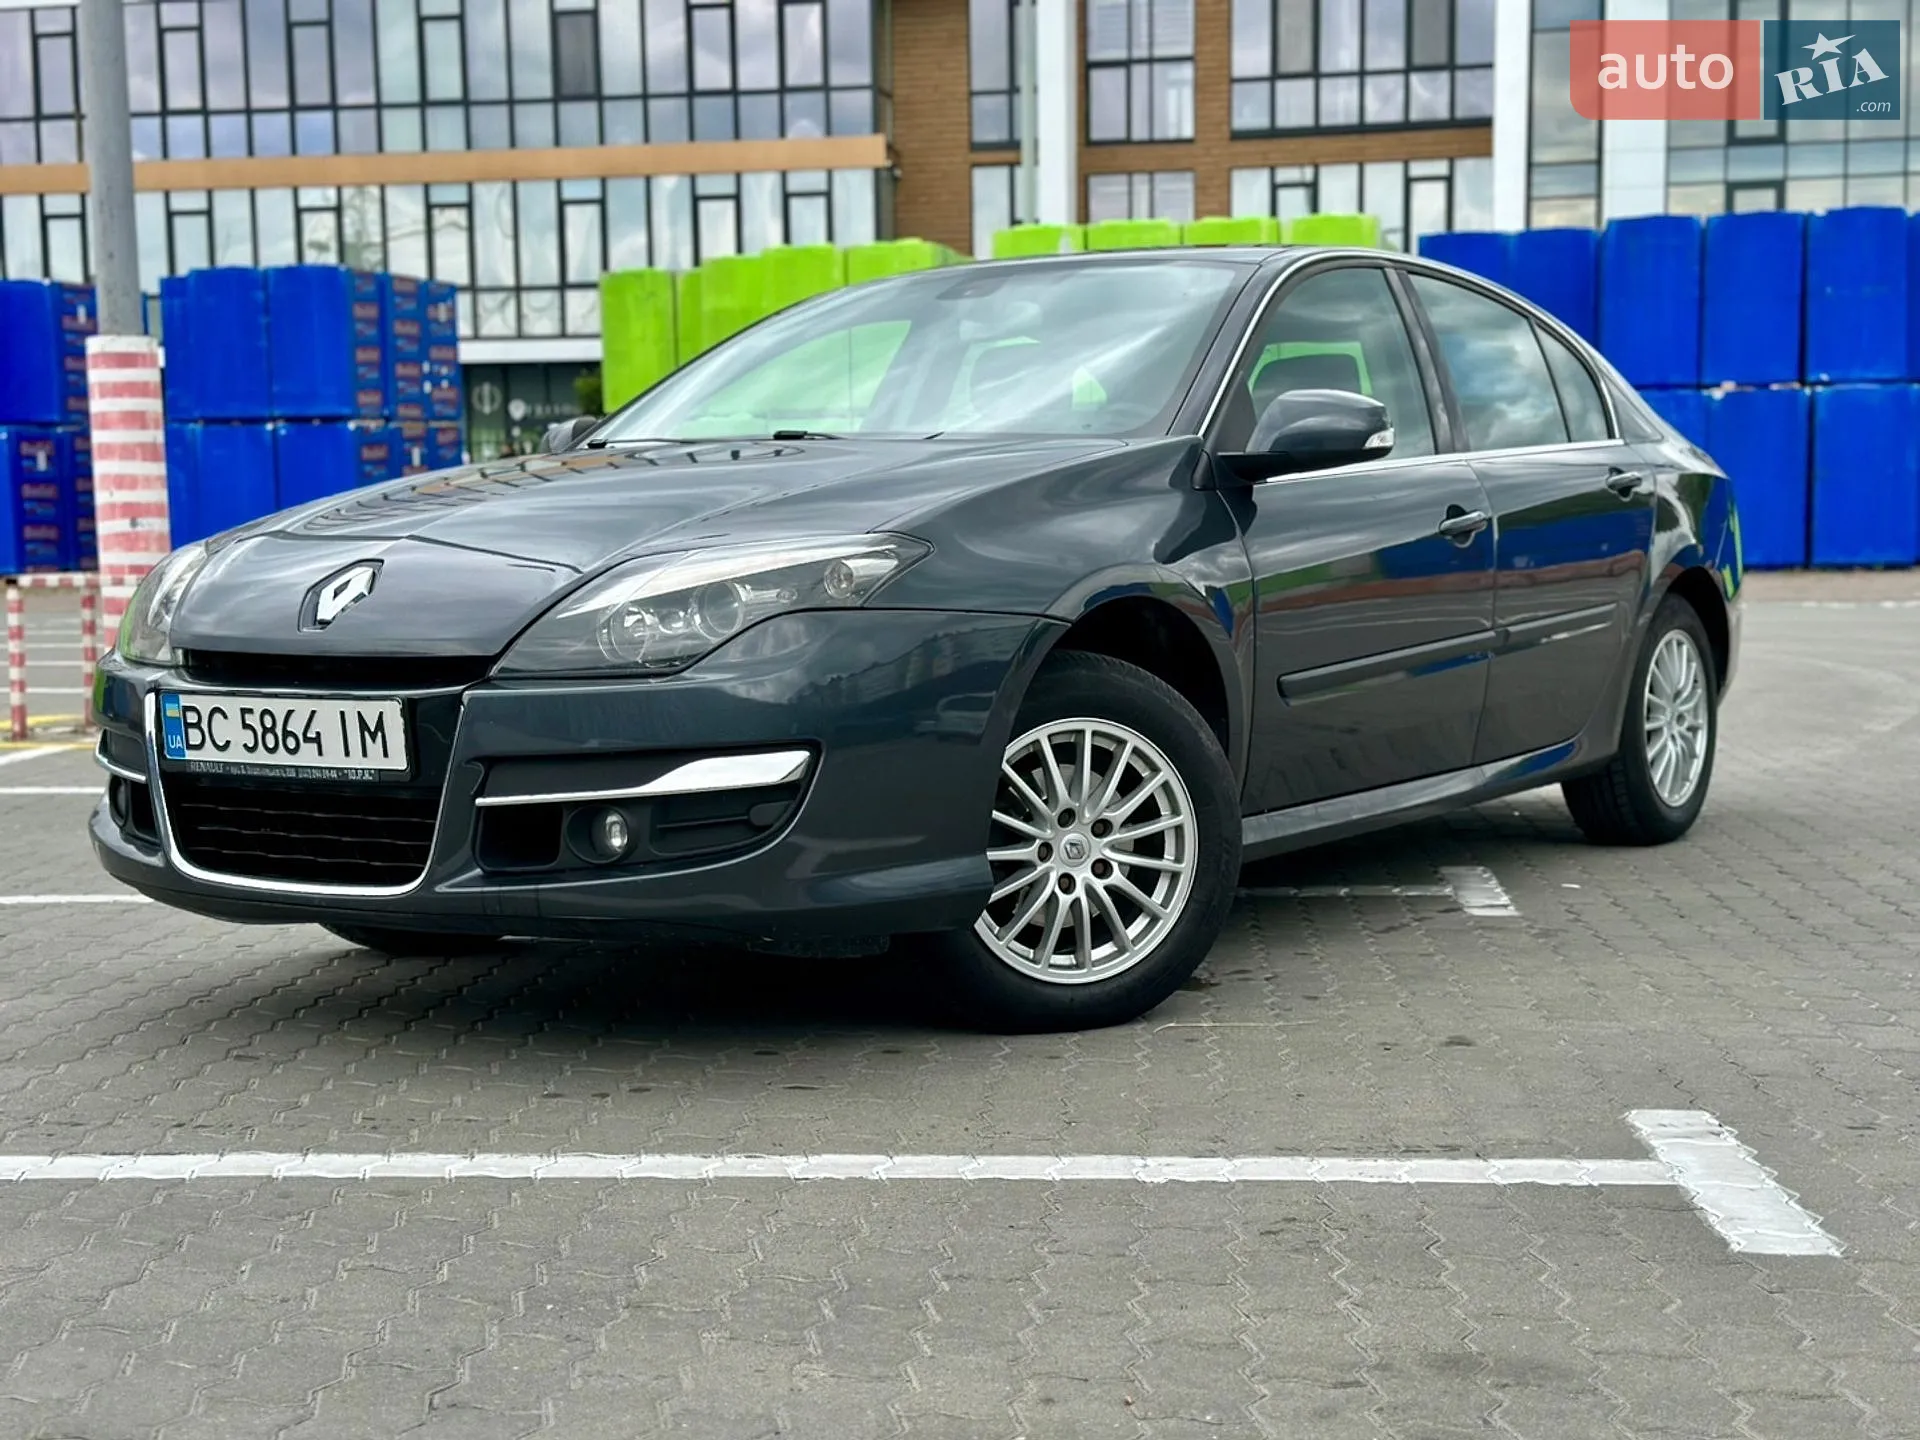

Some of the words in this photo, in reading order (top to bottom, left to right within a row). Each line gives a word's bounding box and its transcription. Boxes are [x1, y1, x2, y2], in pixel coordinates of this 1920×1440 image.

[168, 734, 183, 749] UA
[182, 705, 231, 752] BC
[240, 706, 324, 757] 5864
[339, 710, 389, 758] IM
